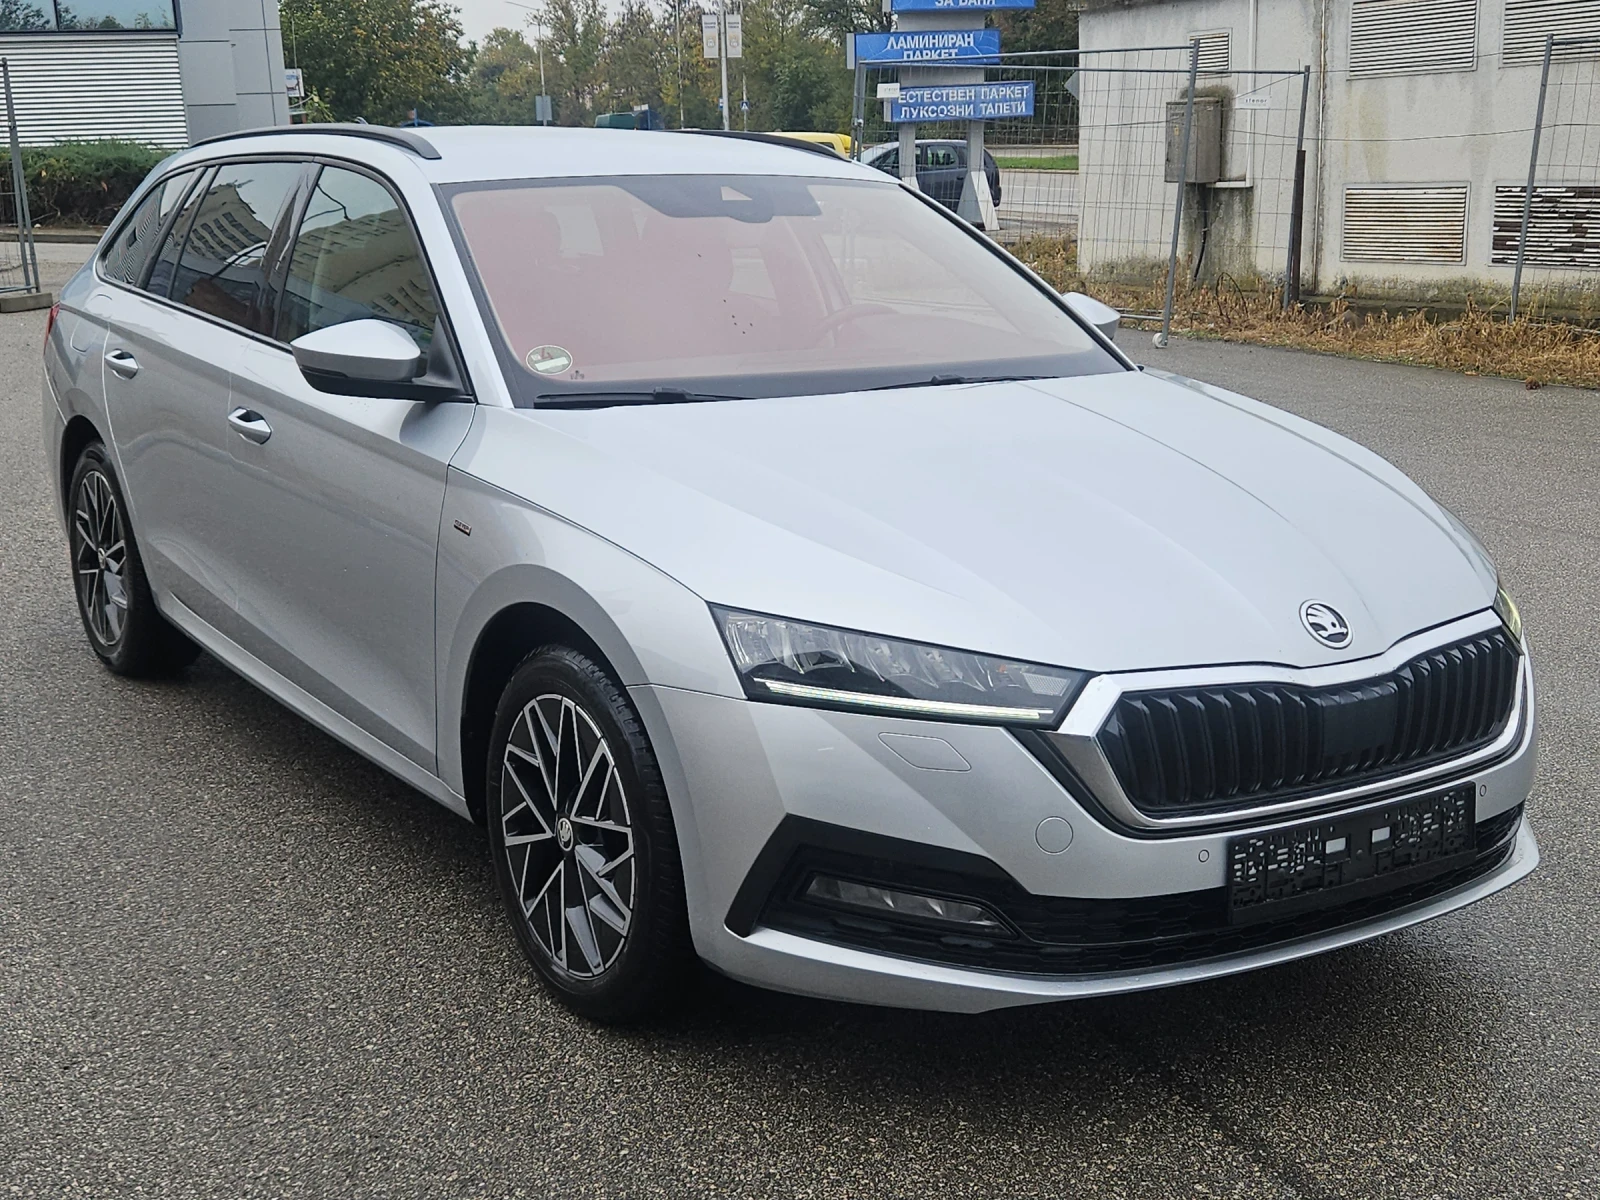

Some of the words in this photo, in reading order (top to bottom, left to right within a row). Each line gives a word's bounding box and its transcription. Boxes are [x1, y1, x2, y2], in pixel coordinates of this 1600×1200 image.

[886, 33, 974, 50] ЛАМИНИРАН
[898, 89, 975, 103] ЕСТЕСТВЕН
[981, 85, 1029, 99] ПАРКЕТ
[901, 104, 974, 119] ЛУКСОЗНИ
[980, 101, 1026, 115] ТАПЕТИ
